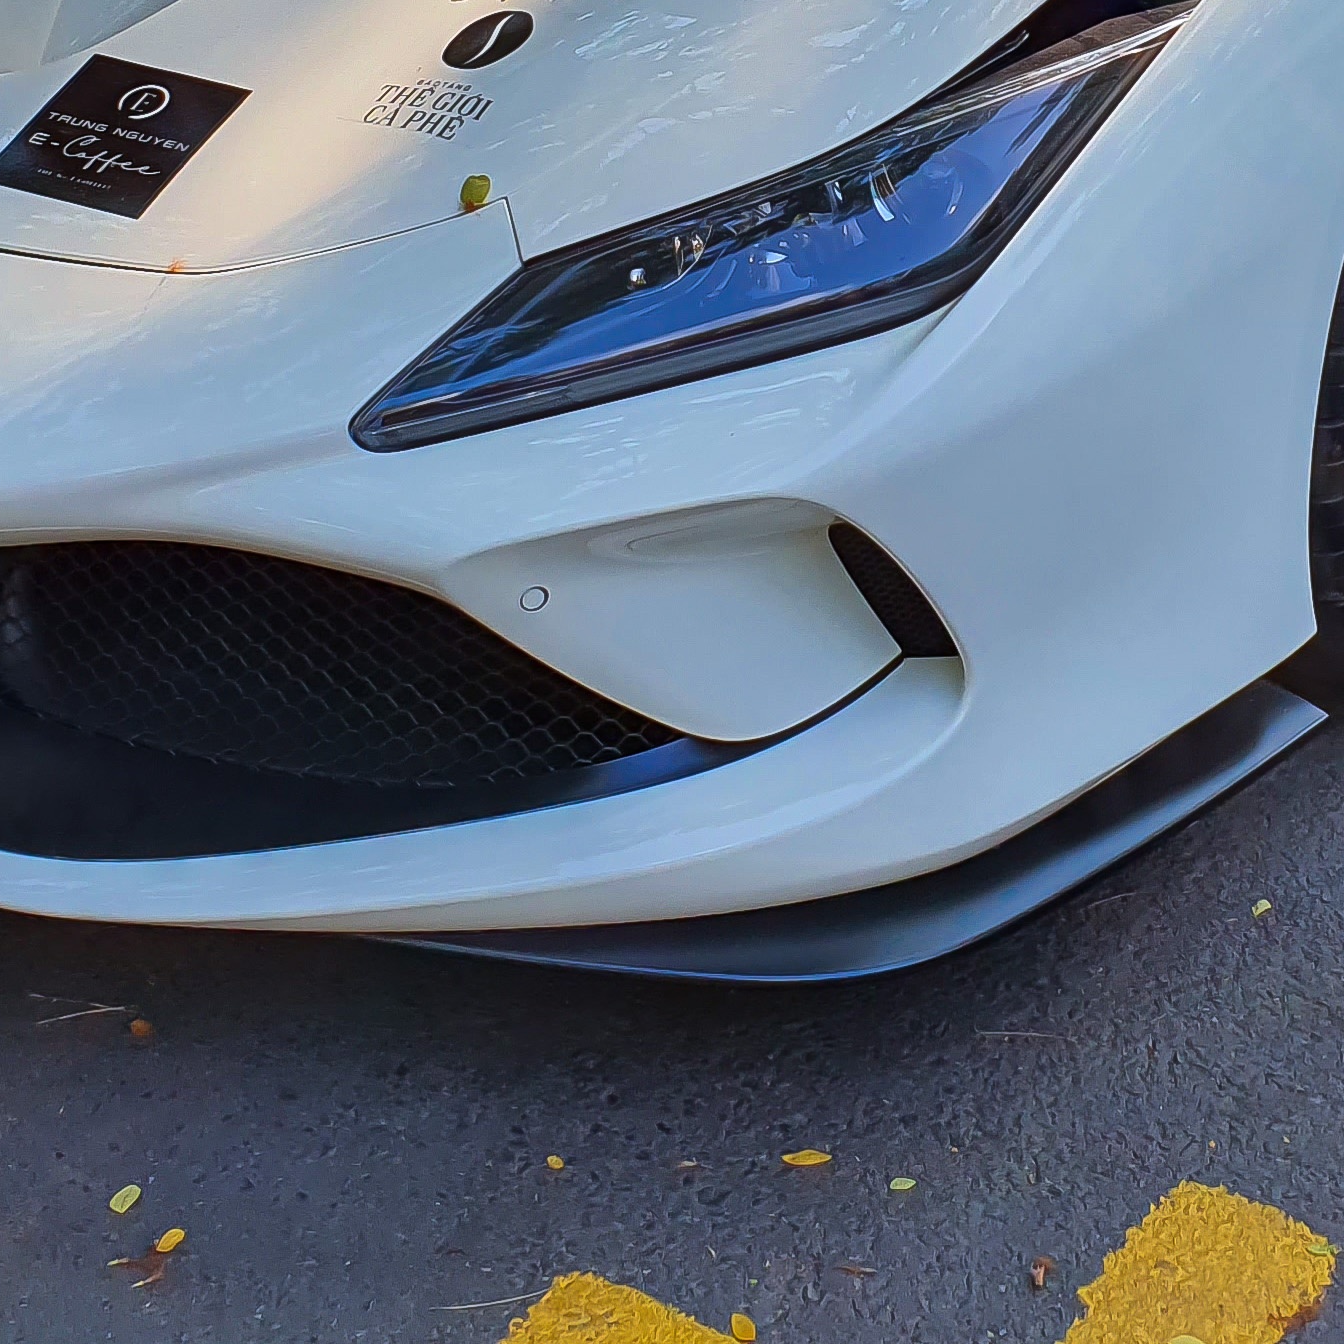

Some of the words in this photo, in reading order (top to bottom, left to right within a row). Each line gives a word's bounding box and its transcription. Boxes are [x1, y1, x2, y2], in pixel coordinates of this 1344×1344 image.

[376, 83, 436, 108] THẾ
[431, 93, 494, 121] GIỚI
[48, 111, 109, 132] TRUNG
[363, 103, 402, 126] CÀ
[399, 110, 465, 141] PHÊ
